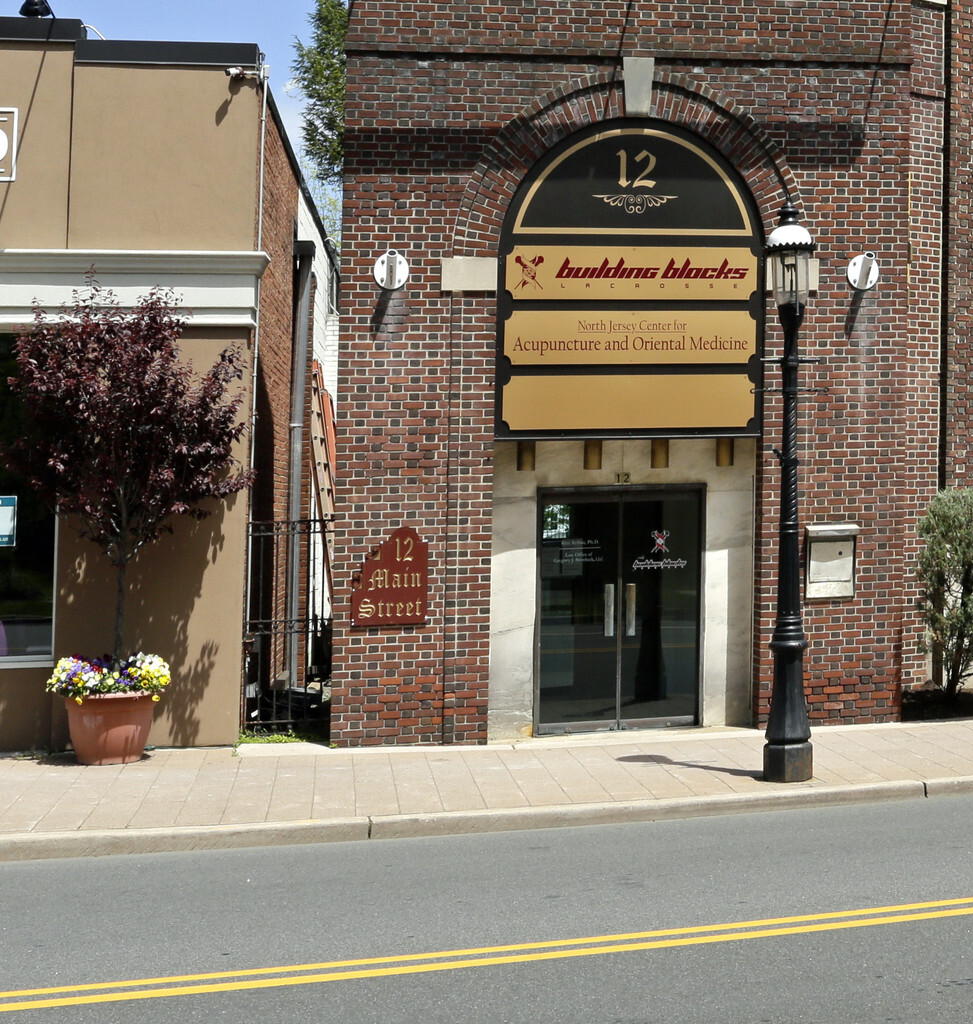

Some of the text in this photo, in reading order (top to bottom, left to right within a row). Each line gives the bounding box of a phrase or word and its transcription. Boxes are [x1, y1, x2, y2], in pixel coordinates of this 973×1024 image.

[616, 149, 657, 188] 12
[555, 257, 749, 280] building blocks
[577, 319, 687, 334] North Jersey Center for
[513, 336, 749, 355] Acupuncture and Oriental Medicine
[616, 473, 630, 484] 12
[395, 537, 414, 562] 12
[367, 567, 422, 591] Main
[358, 598, 422, 619] Street
